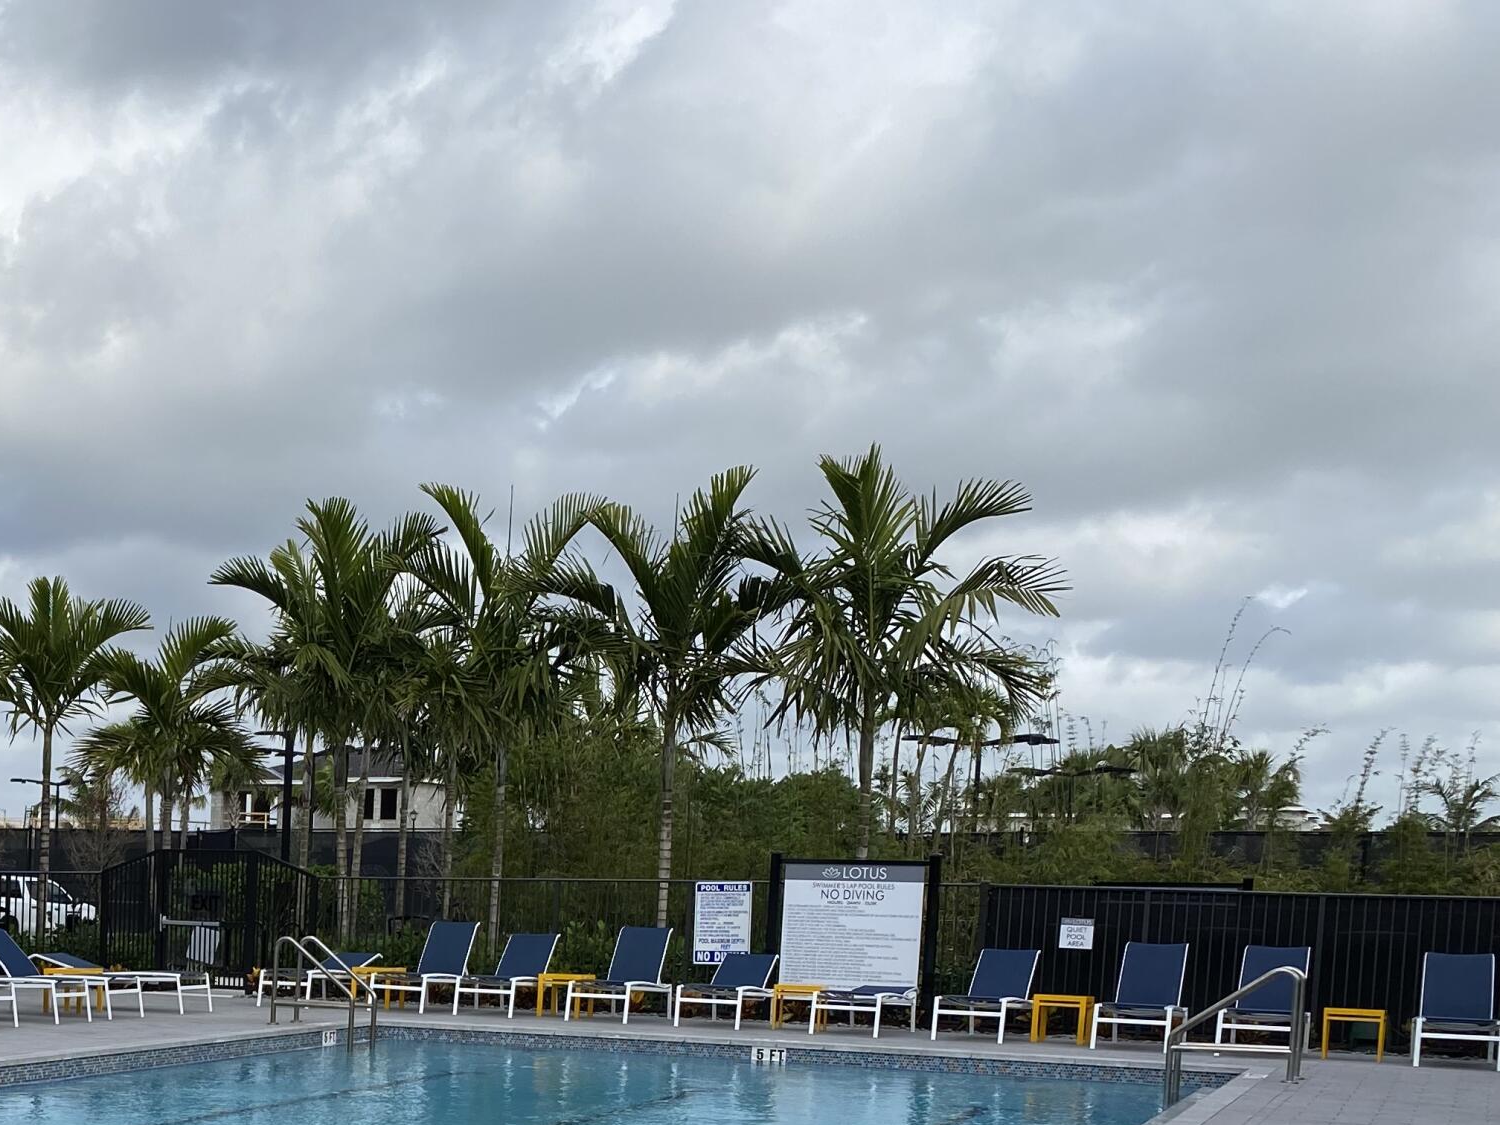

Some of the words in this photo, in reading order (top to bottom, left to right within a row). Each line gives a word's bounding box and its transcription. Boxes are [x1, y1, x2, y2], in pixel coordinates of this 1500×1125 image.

[842, 866, 888, 880] LOTUS
[821, 889, 840, 900] NO
[843, 889, 885, 901] DIVING
[191, 895, 220, 912] EXIT
[696, 951, 711, 962] NO
[756, 1048, 764, 1060] 5
